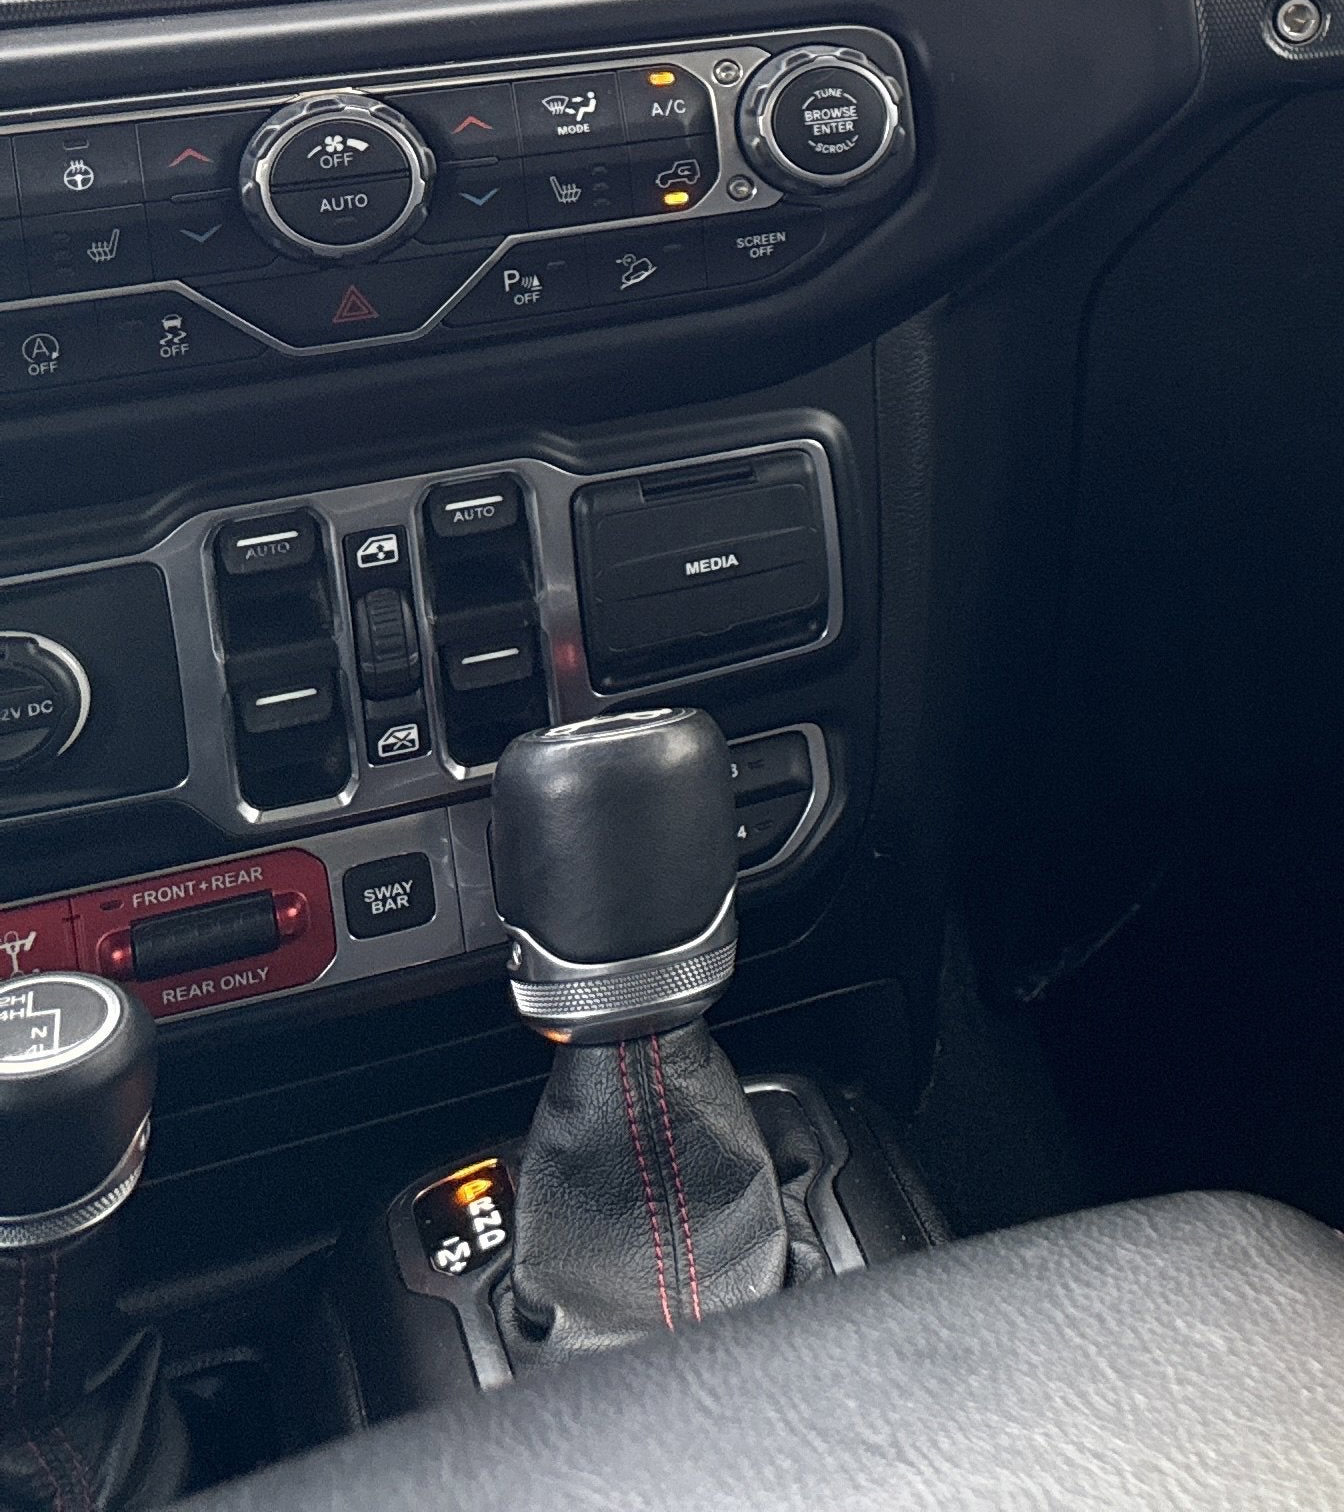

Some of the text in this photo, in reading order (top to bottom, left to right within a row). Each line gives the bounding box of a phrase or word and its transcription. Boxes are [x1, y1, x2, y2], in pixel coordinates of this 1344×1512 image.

[813, 88, 843, 99] TUNE
[651, 99, 687, 117] A/C
[804, 105, 857, 122] BROWSE
[557, 122, 590, 136] MODE
[813, 121, 855, 136] ENTER
[815, 139, 856, 154] SCROLL
[319, 153, 354, 169] OFF
[320, 193, 368, 213] AUTO
[736, 231, 786, 249] SCREEN
[749, 245, 774, 259] OFF
[513, 292, 541, 306] OFF
[159, 343, 190, 359] OFF
[27, 361, 59, 376] OFF
[453, 504, 496, 524] AUTO
[245, 541, 291, 561] AUTO
[685, 554, 740, 576] MEDIA
[28, 699, 54, 717] DC
[737, 825, 747, 838] 4
[363, 879, 414, 903] SWAY
[371, 894, 410, 915] BAR
[162, 967, 270, 1006] REAR ONLY
[31, 1025, 48, 1039] N
[459, 1178, 493, 1204] P
[469, 1196, 496, 1216] R
[473, 1210, 502, 1232] N
[478, 1229, 506, 1250] D
[437, 1241, 471, 1267] M
